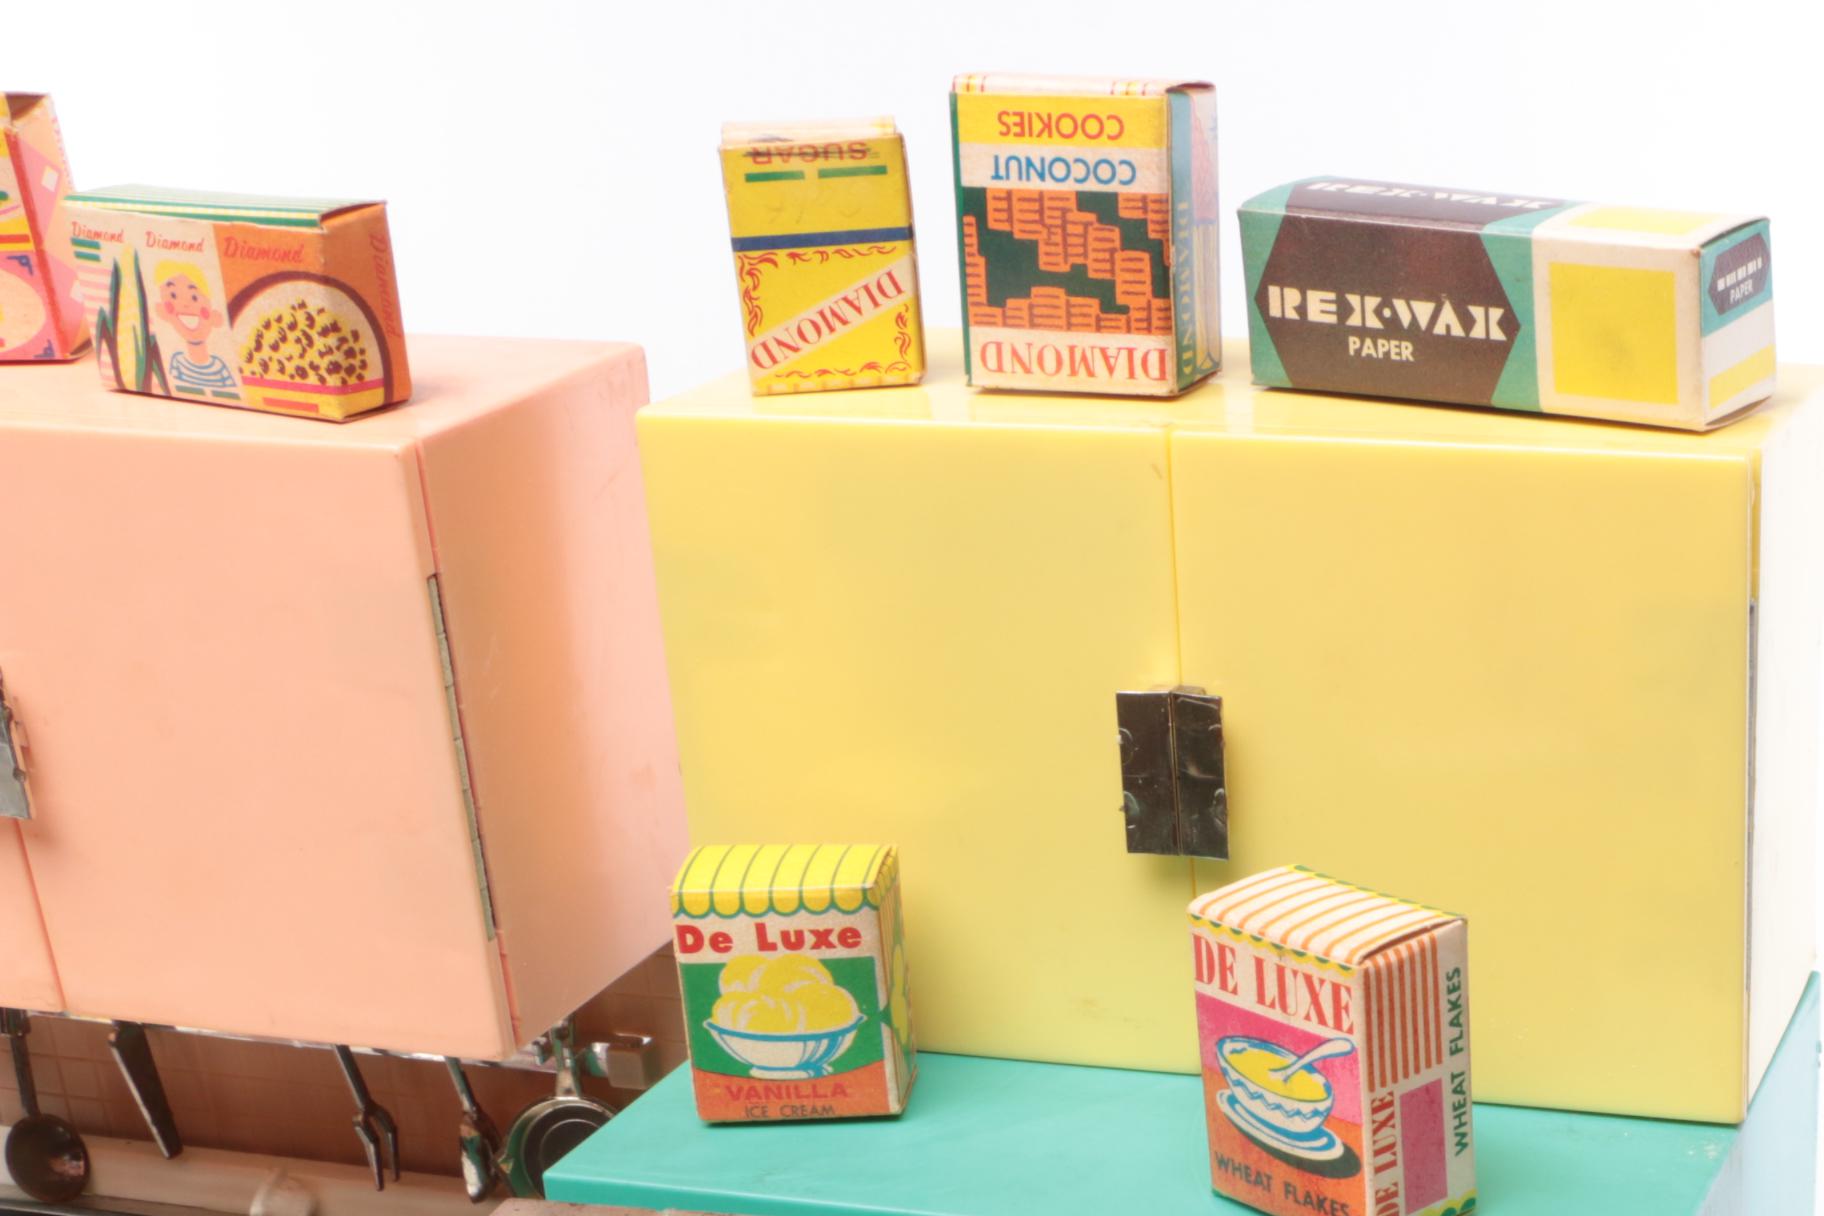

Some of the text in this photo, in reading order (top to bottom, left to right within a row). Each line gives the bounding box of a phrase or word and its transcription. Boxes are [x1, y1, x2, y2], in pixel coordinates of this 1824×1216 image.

[998, 110, 1124, 141] COOKIES
[751, 140, 868, 165] SUGAR
[991, 154, 1136, 186] COCONUT
[72, 221, 124, 243] Diamond
[145, 231, 205, 252] Diamond
[223, 236, 304, 263] Diamond
[751, 267, 906, 370] DIAMOND
[980, 340, 1168, 381] DIAMOND
[1348, 335, 1415, 362] PAPER
[675, 922, 863, 954] De Luxe
[1191, 932, 1355, 1036] DE LUXE
[1447, 966, 1469, 1156] WHEAT FLAKES
[725, 1081, 850, 1102] VANILLA
[745, 1104, 836, 1119] ICE CREAM
[1370, 1090, 1398, 1175] LUXE
[1214, 1151, 1273, 1192] WHEAT
